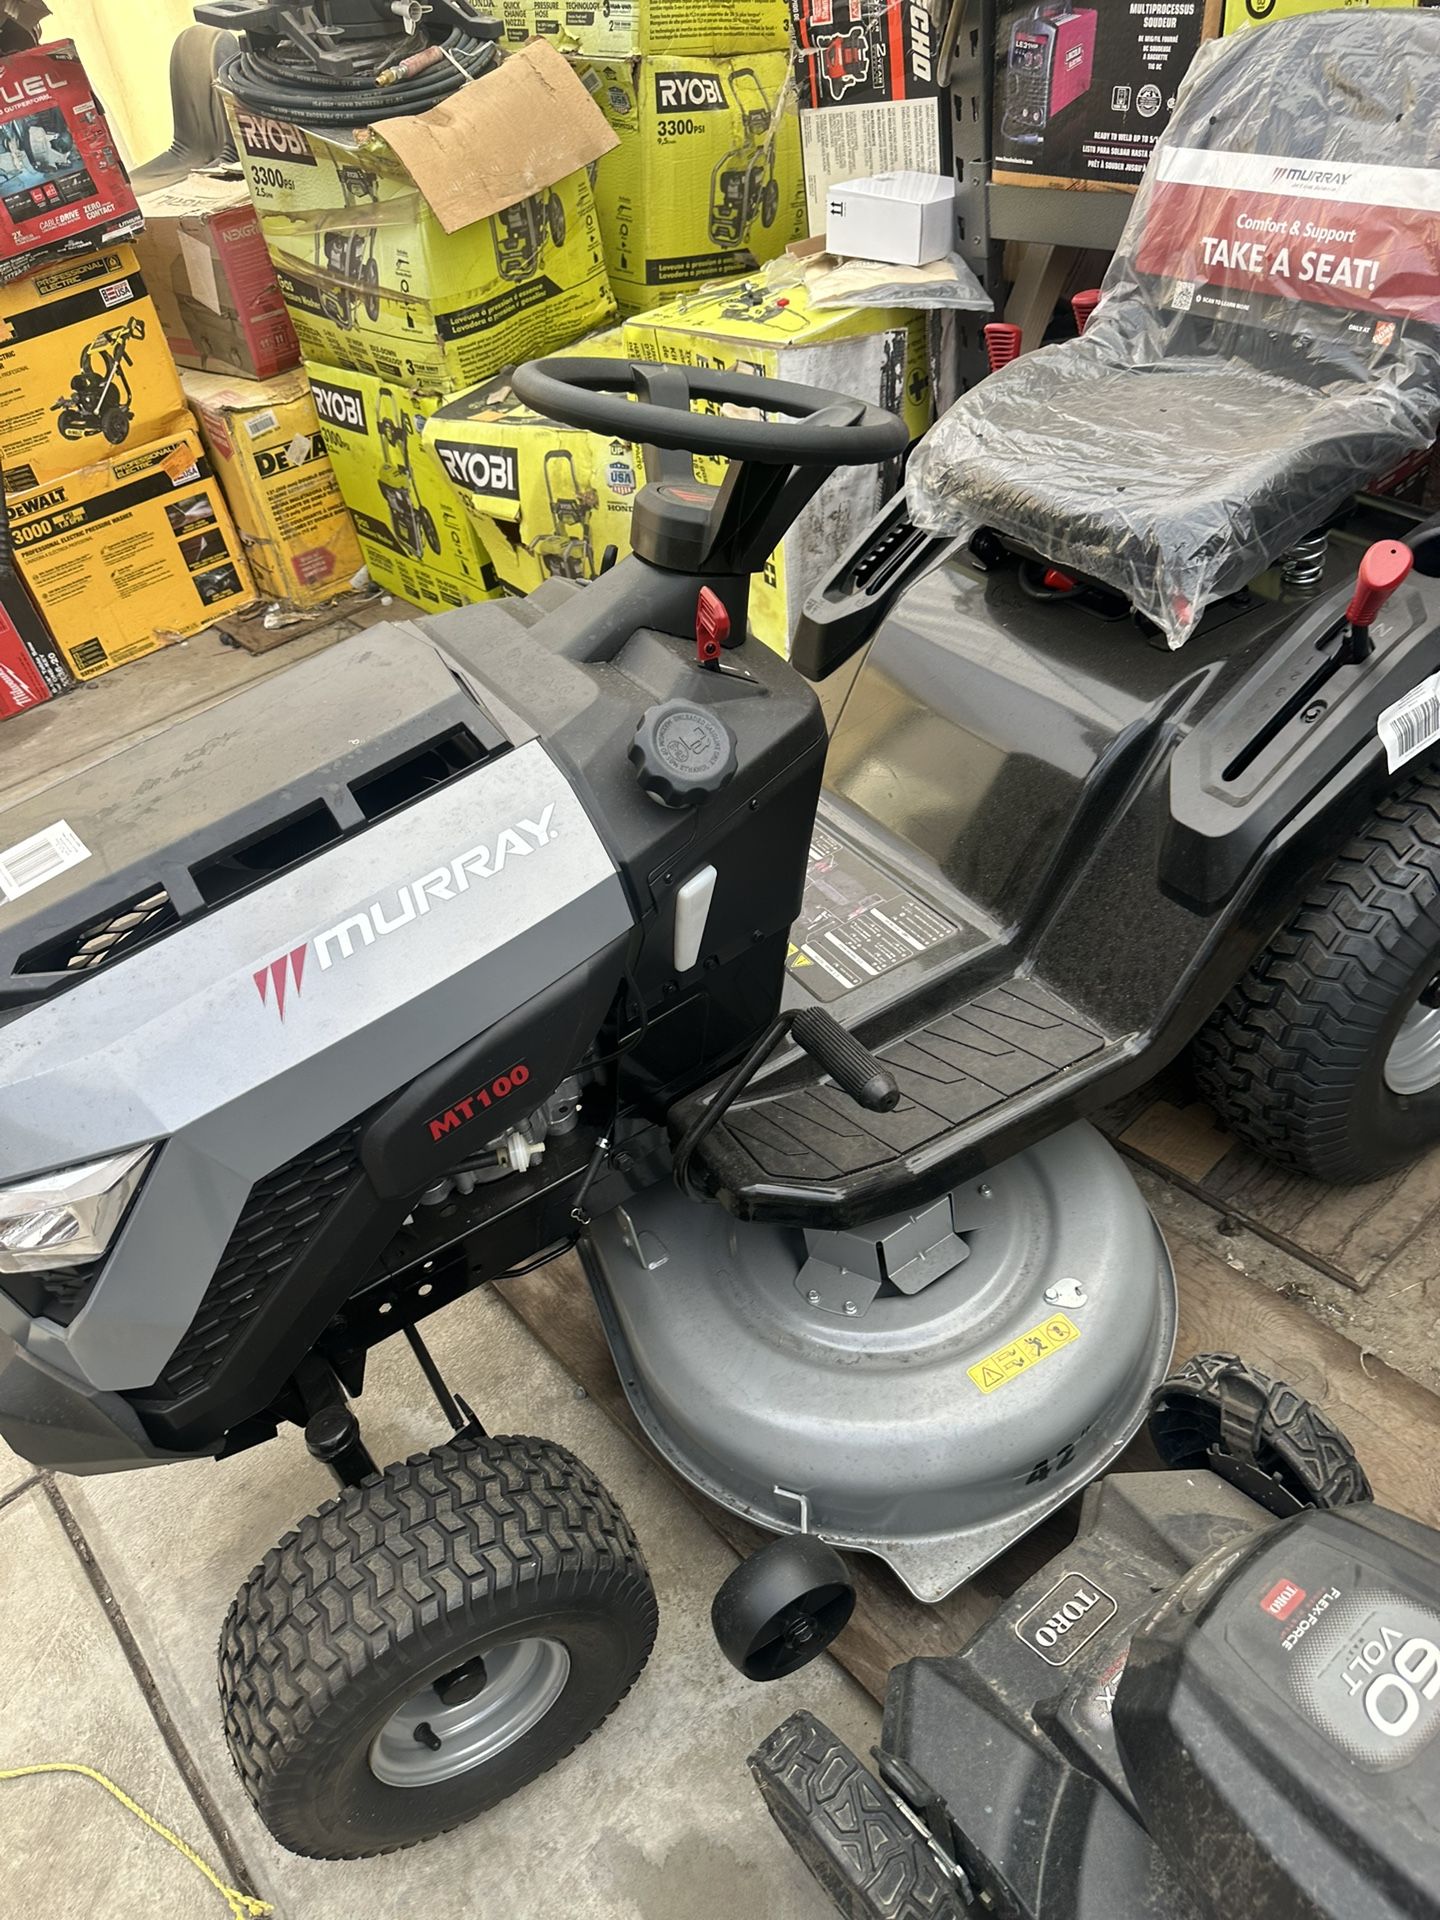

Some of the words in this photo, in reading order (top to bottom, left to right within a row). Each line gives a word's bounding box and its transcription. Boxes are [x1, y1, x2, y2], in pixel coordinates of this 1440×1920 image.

[534, 1, 560, 9] PRESSURE
[566, 2, 600, 10] TECHNOLOGY
[1129, 3, 1195, 15] MULTIPROCESSUS
[504, 9, 526, 18] CHANGE
[535, 10, 549, 18] HOSE
[1143, 17, 1177, 28] SOUDEUR
[909, 0, 932, 82] CHO
[1, 73, 68, 104] UEL
[659, 78, 723, 107] RYOBI
[238, 114, 309, 155] RYOBI
[1094, 131, 1111, 140] READY
[1111, 132, 1118, 140] TO
[1118, 133, 1132, 142] WELD
[1133, 134, 1141, 142] UP
[1141, 135, 1149, 143] TO
[1082, 144, 1096, 153] LISTO
[1096, 146, 1110, 155] PARA
[1130, 149, 1148, 158] HASTA
[1087, 159, 1100, 168] PRÊT
[1105, 161, 1124, 171] SOUDER
[1286, 168, 1352, 186] MURRAY
[83, 201, 101, 213] ZERO
[86, 204, 116, 220] CONTACT
[1236, 213, 1287, 235] Comfort
[1289, 220, 1301, 236] &
[1303, 222, 1357, 244] Support
[659, 264, 685, 272] Laveuse
[1201, 237, 1267, 273] TAKE
[1270, 248, 1290, 278] A
[1299, 251, 1380, 291] SEAT!
[36, 261, 104, 286] PROFESSIONAL
[659, 271, 689, 280] Lavadora
[40, 276, 81, 294] ELECTRIC
[277, 274, 295, 292] Gas
[115, 286, 131, 298] USA
[1202, 296, 1215, 305] SCAN
[1214, 298, 1221, 306] TO
[1221, 299, 1236, 309] LEARN
[449, 312, 480, 326] Laveuse
[451, 317, 487, 334] Lavadora
[1348, 324, 1363, 332] ONLY
[0, 351, 16, 361] CTRIC
[314, 386, 365, 427] RYOBI
[611, 446, 624, 456] UP
[115, 445, 173, 474] PROFESSIONAL
[117, 462, 154, 478] ELECTRIC
[183, 468, 198, 479] USA
[438, 449, 516, 490] RYOBI
[611, 472, 632, 484] USA
[11, 520, 53, 545] 3000
[21, 539, 60, 558] PROFESSIONAL
[60, 530, 85, 544] ELECTRIC
[85, 519, 112, 535] PRESSURE
[111, 511, 134, 525] WASHER
[27, 641, 38, 657] Saw
[313, 802, 556, 972] MURRAY
[427, 1065, 531, 1143] MT100
[1268, 1585, 1299, 1614] TORO
[1035, 1586, 1100, 1648] TORO
[1340, 1626, 1404, 1697] VOLT
[1364, 1637, 1440, 1737] 60
